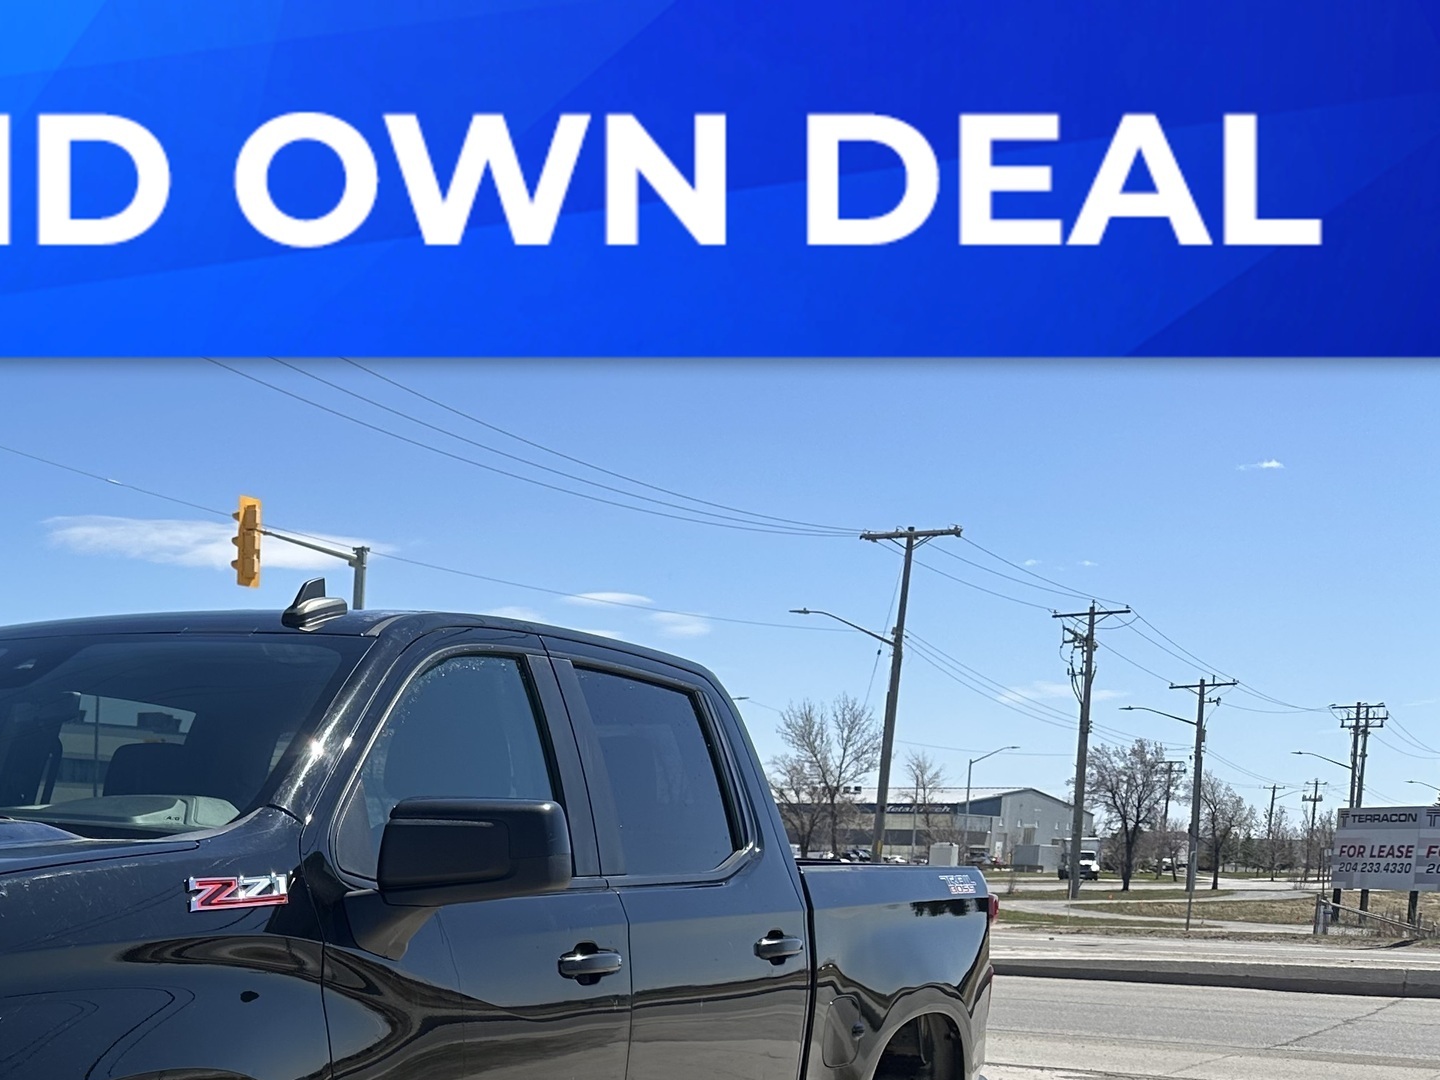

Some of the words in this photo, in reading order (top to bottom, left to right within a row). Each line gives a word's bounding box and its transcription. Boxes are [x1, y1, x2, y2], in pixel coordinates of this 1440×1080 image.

[1351, 813, 1418, 823] TERRACON
[1339, 844, 1366, 858] FOR
[1369, 845, 1415, 859] LEASE
[1338, 862, 1412, 874] 204.233.4330
[188, 873, 289, 913] Z71
